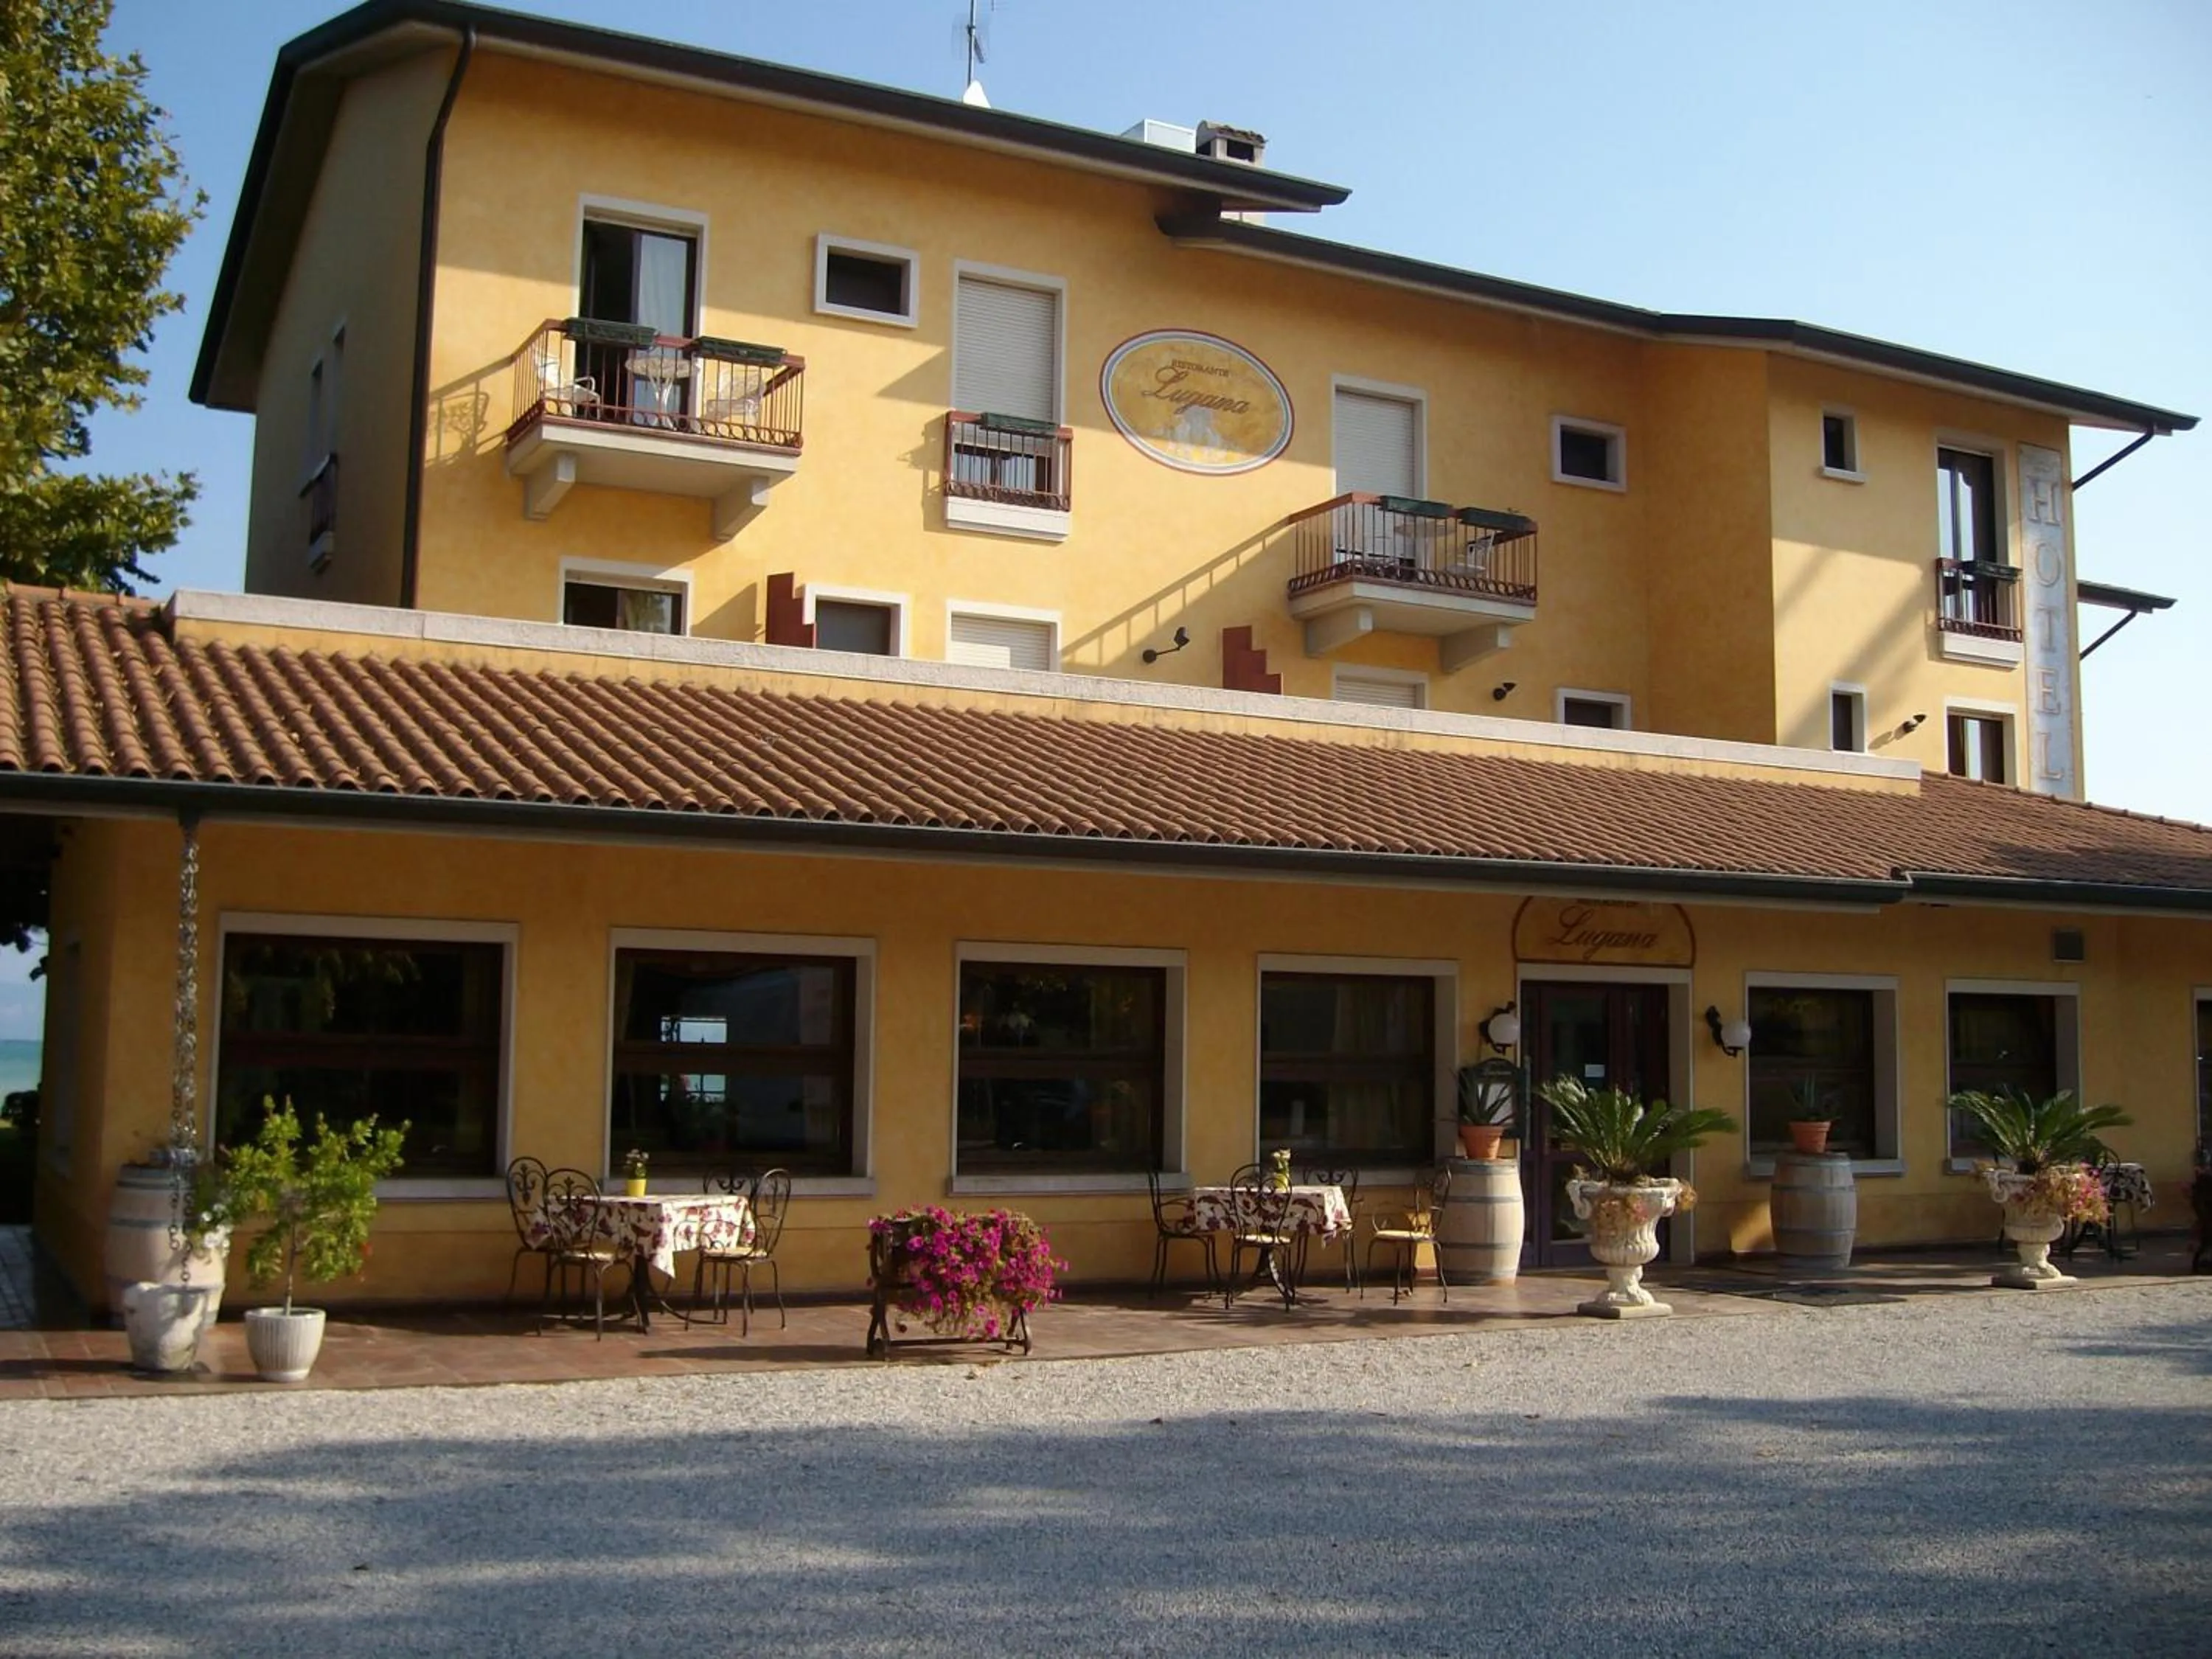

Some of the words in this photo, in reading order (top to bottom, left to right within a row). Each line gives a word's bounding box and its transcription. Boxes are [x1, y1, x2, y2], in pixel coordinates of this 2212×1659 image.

[1141, 366, 1251, 414] Lugana
[2026, 474, 2064, 781] HOTEL
[1545, 905, 1659, 962] Lugana
